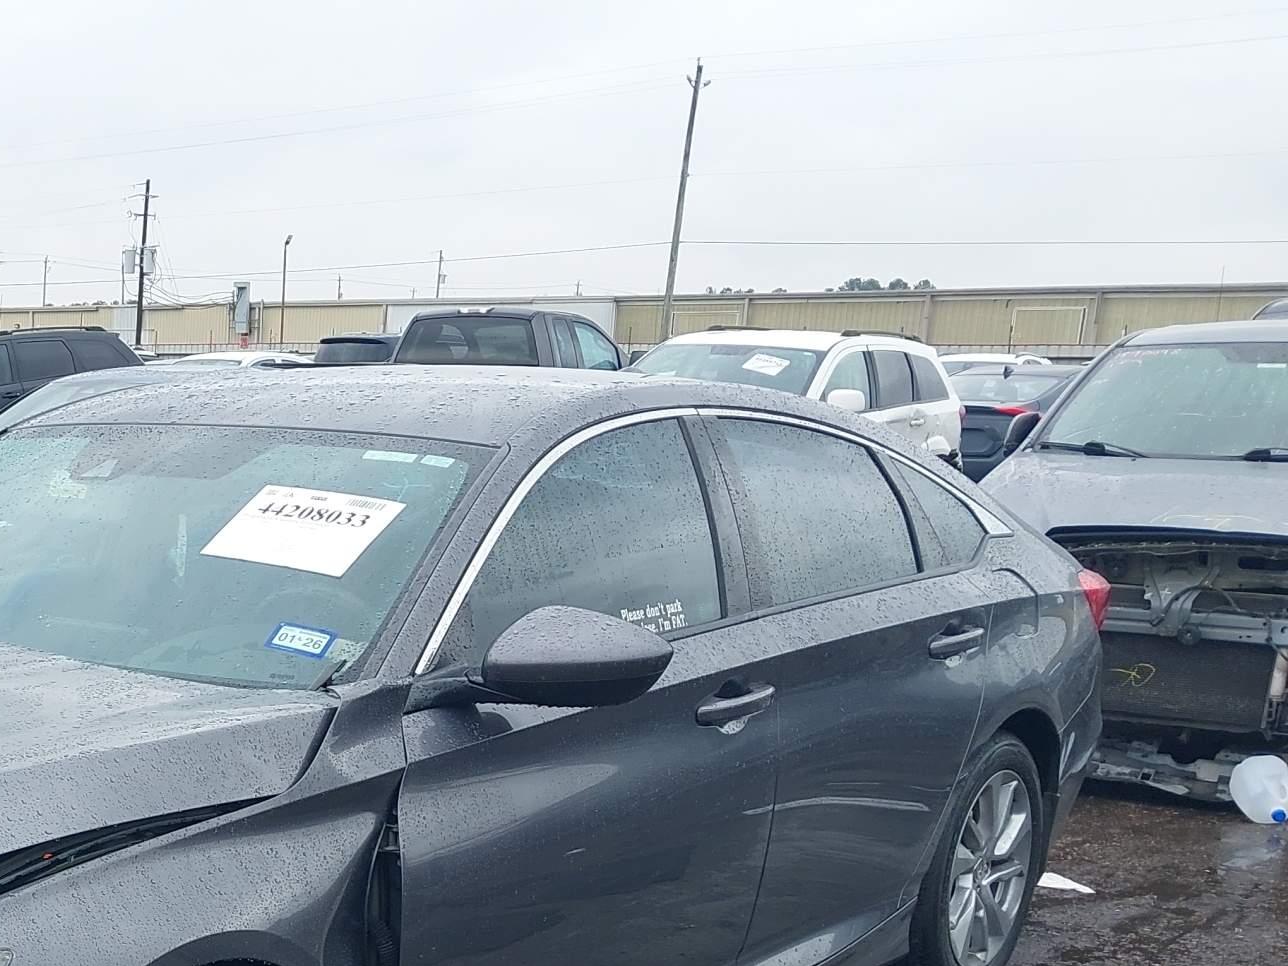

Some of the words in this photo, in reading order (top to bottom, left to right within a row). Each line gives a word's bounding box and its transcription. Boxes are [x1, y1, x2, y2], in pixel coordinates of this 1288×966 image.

[257, 502, 372, 528] 44208033
[620, 607, 645, 622] Please
[646, 602, 666, 618] don't
[666, 599, 683, 618] park
[658, 618, 672, 631] I'm
[302, 637, 323, 650] 26
